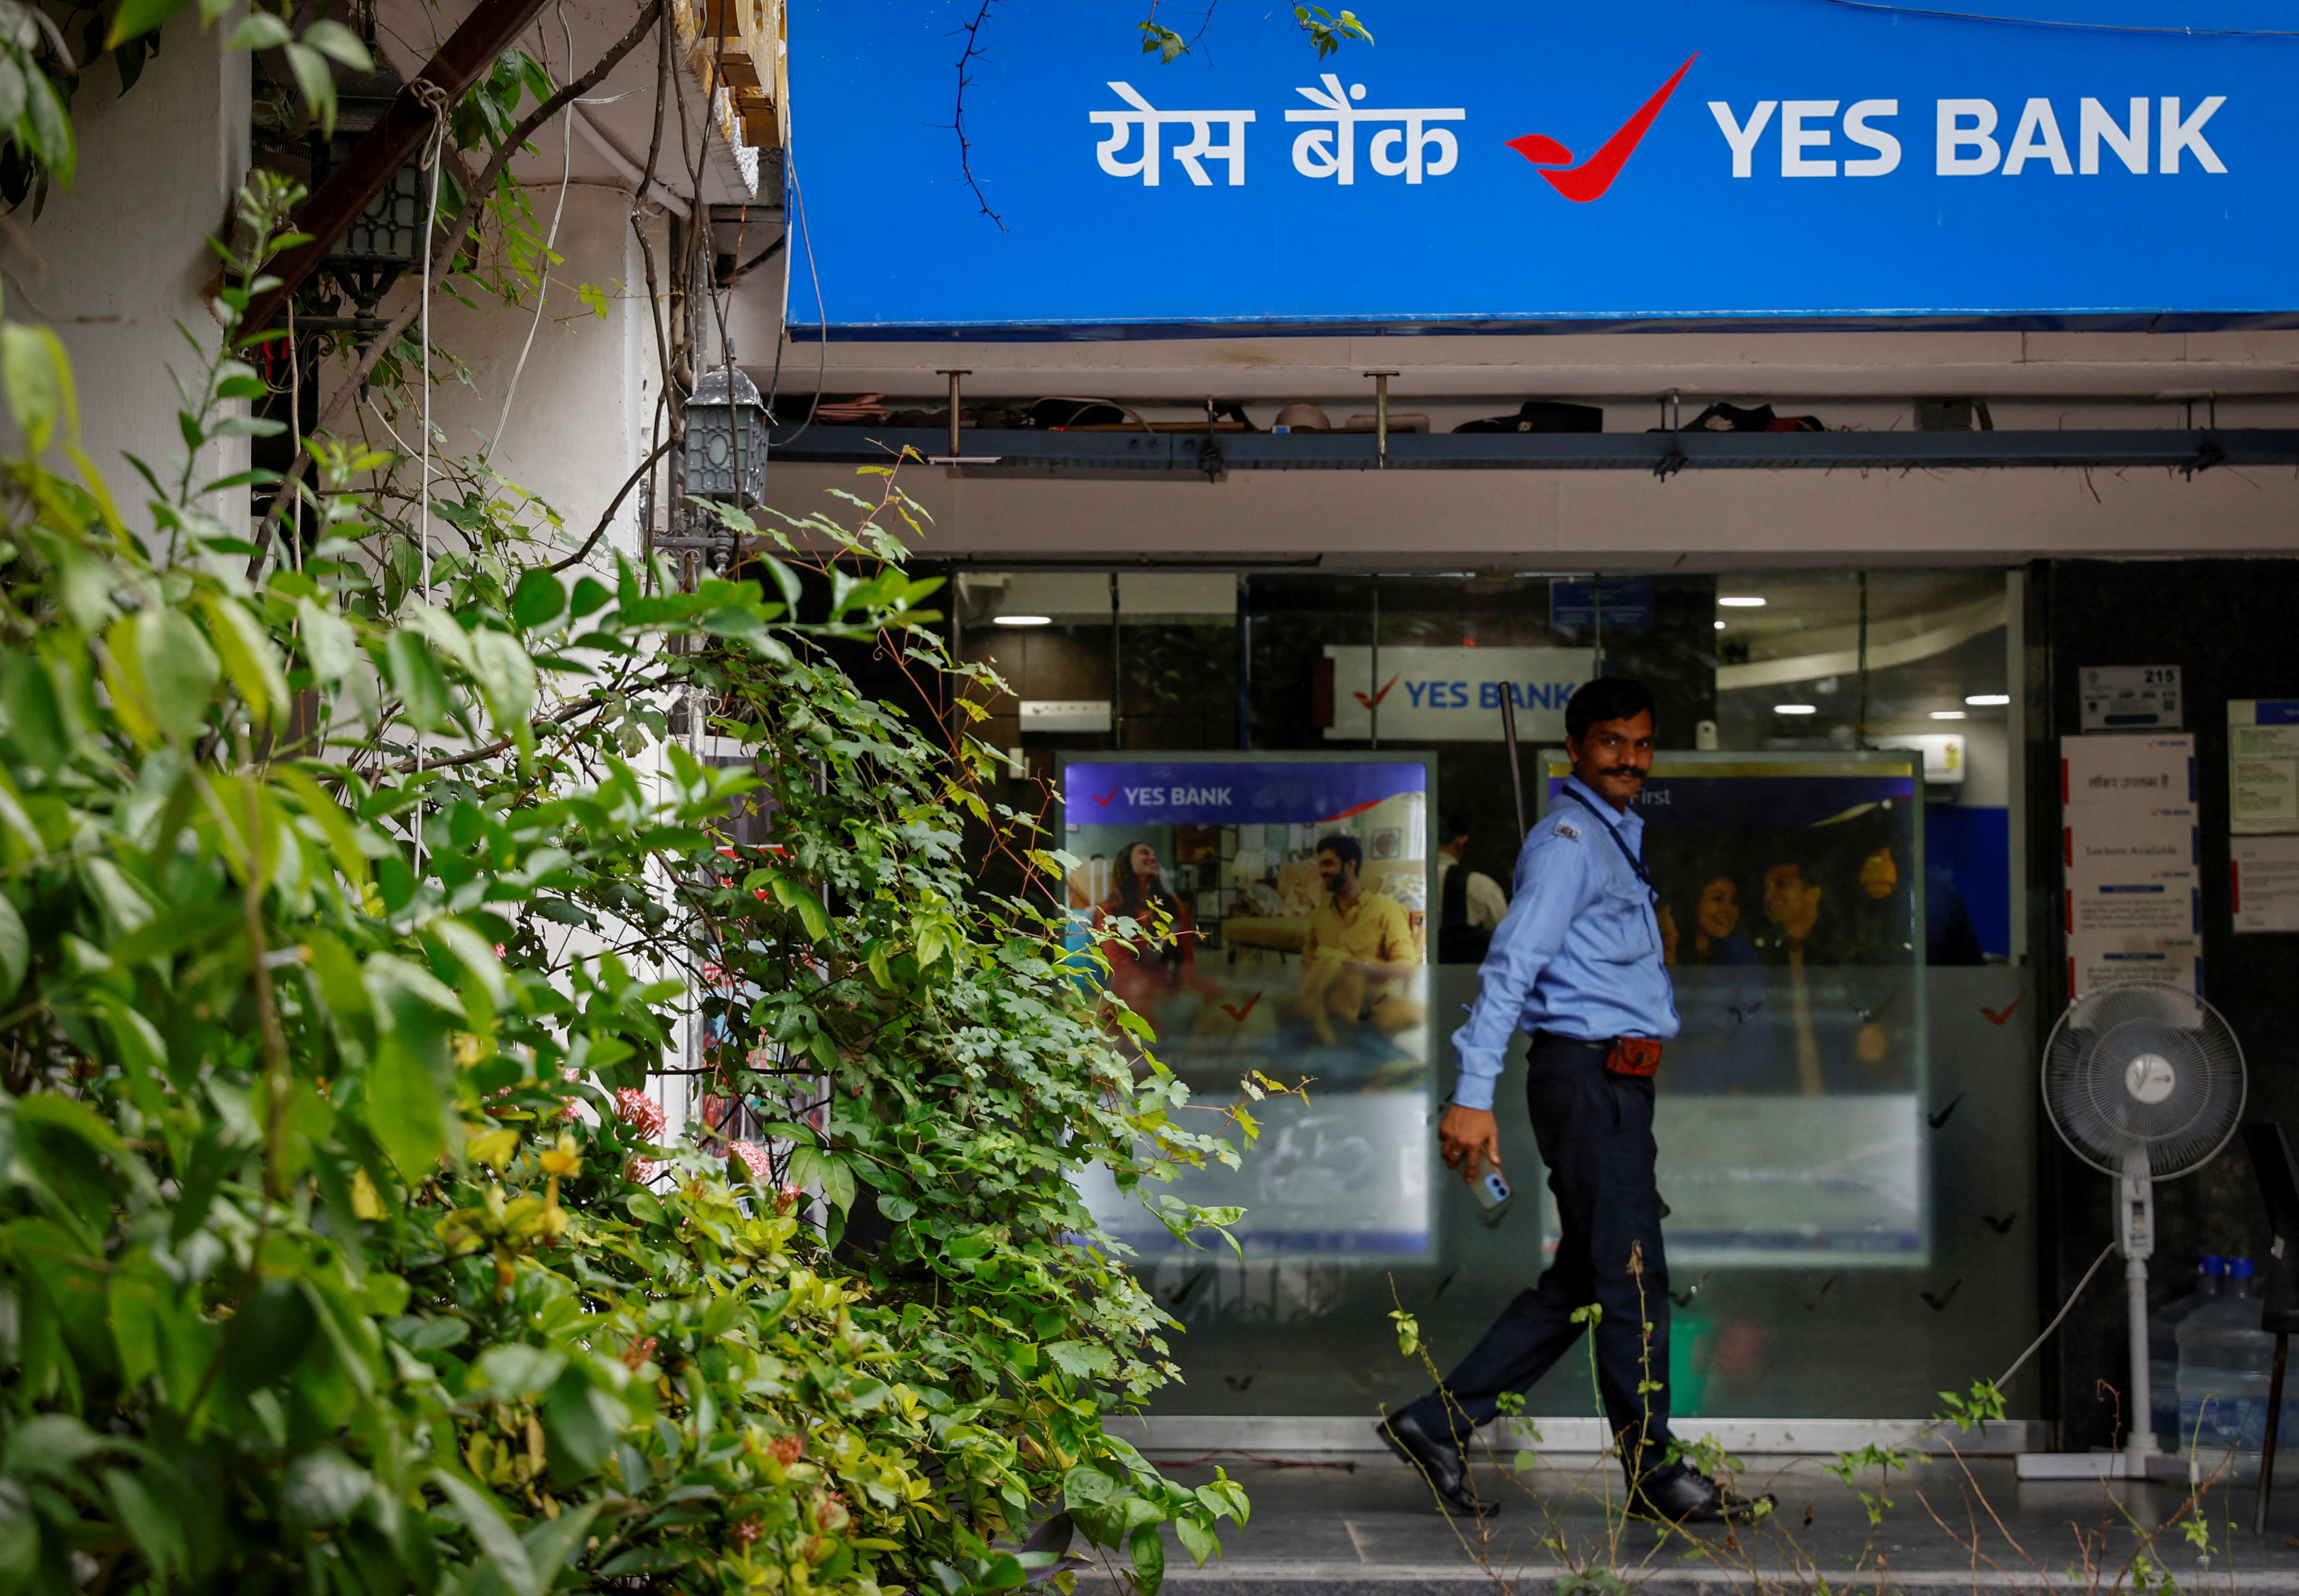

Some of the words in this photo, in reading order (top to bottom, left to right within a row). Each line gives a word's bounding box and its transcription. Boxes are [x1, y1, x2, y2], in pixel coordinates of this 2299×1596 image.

[1090, 81, 1256, 186] येस
[1285, 73, 1466, 185] बैंक
[1708, 99, 1901, 178] YES
[1936, 96, 2228, 176] BANK
[2145, 669, 2174, 683] 215
[1405, 681, 1469, 708] YES
[1480, 682, 1575, 709] BANK
[1124, 787, 1166, 806] YES
[1171, 787, 1232, 806] BANK
